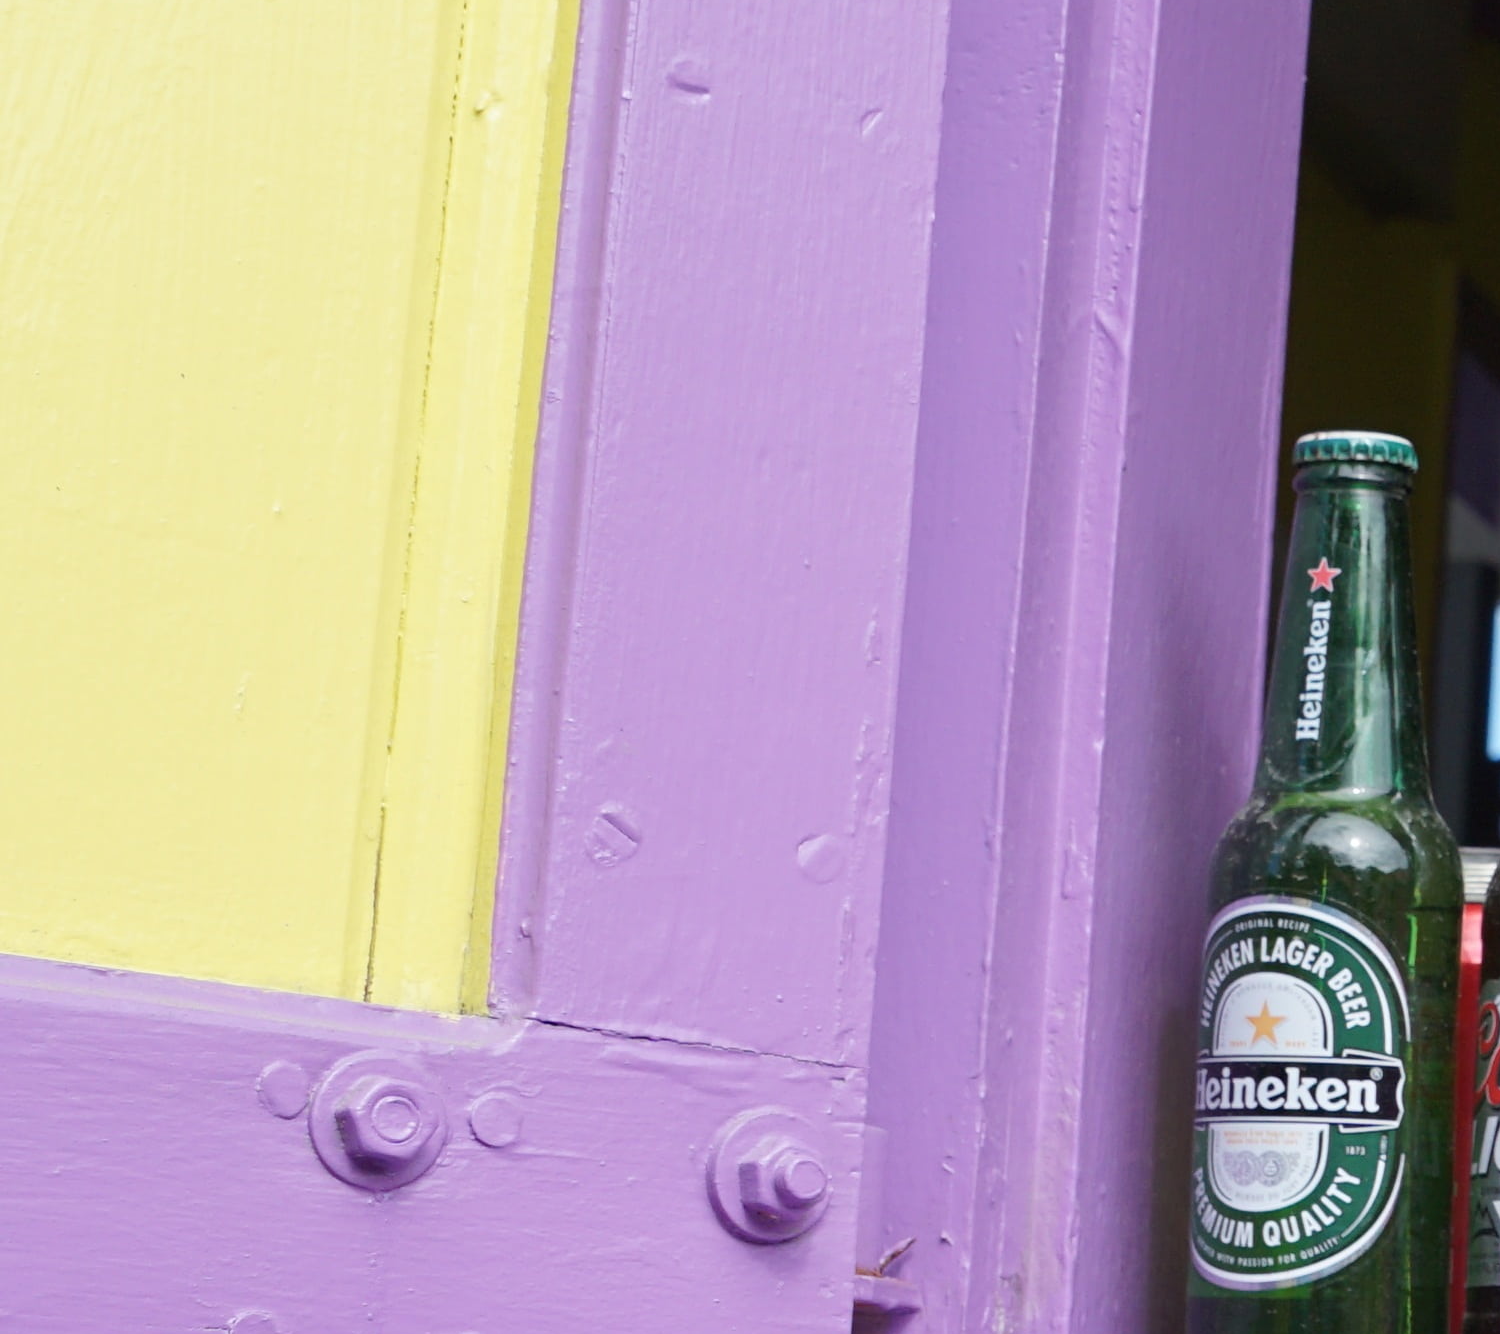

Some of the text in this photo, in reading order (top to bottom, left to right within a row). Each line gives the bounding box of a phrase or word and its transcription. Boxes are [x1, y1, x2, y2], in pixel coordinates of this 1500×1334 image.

[1296, 599, 1332, 741] Heineken
[1235, 918, 1310, 933] ORIGINAL RECIPE
[1200, 938, 1254, 1027] HEINEKEN
[1260, 936, 1334, 979] LAGER
[1327, 968, 1371, 1029] BEER
[1195, 1066, 1380, 1113] Heineken
[1193, 1167, 1361, 1248] PREMIUM QUALITY
